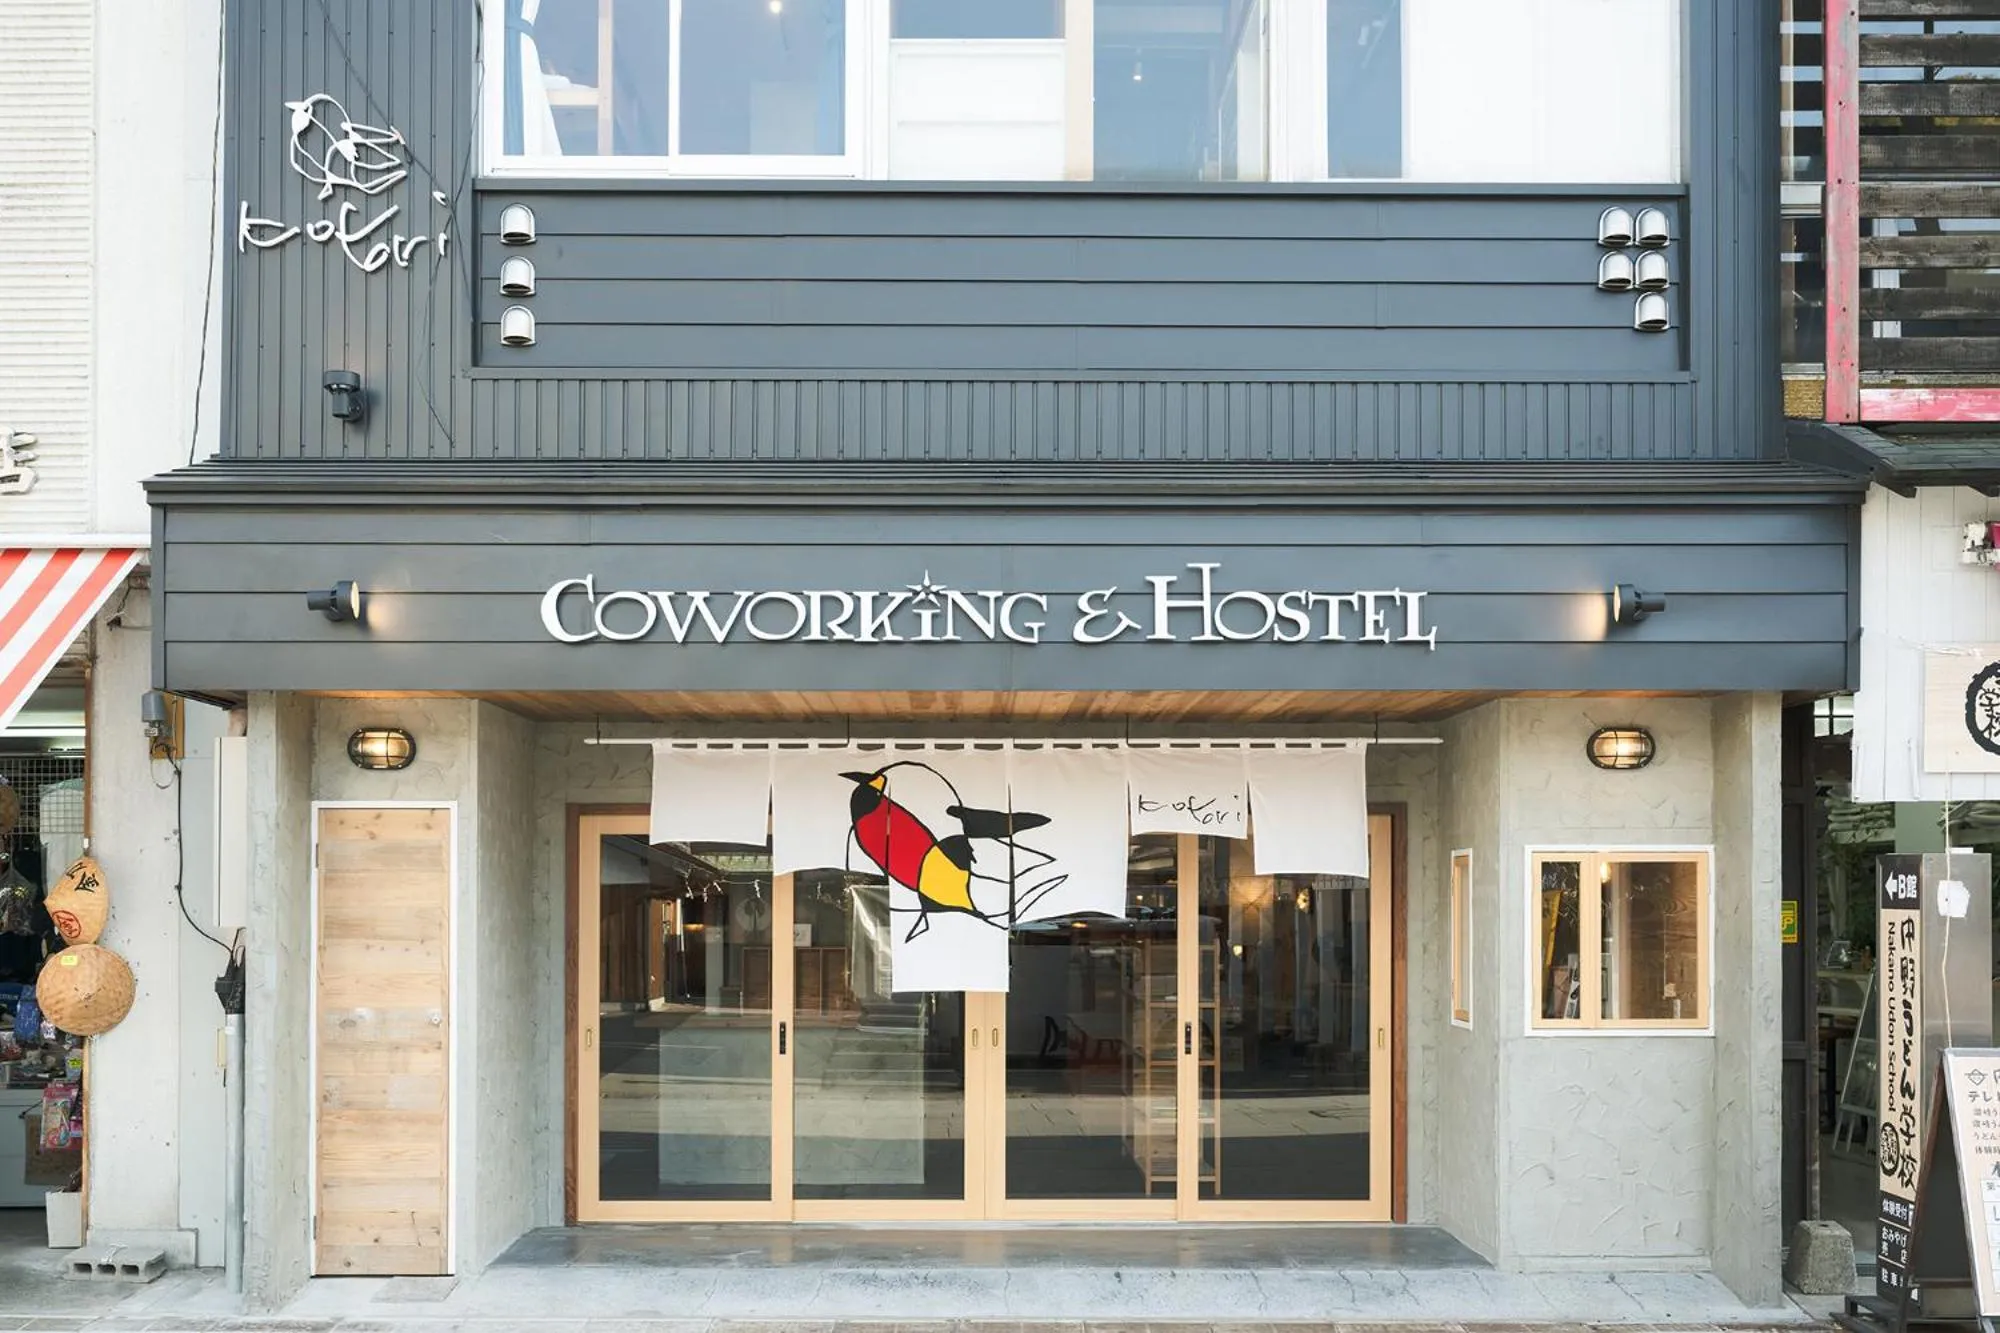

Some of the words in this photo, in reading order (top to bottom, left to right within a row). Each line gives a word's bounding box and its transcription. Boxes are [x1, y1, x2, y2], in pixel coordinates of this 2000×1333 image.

[1071, 585, 1142, 644] &
[1144, 561, 1438, 651] HOSTEL
[1887, 921, 1897, 993] Nakano
[1887, 996, 1897, 1046] Udon
[1887, 1050, 1897, 1113] School
